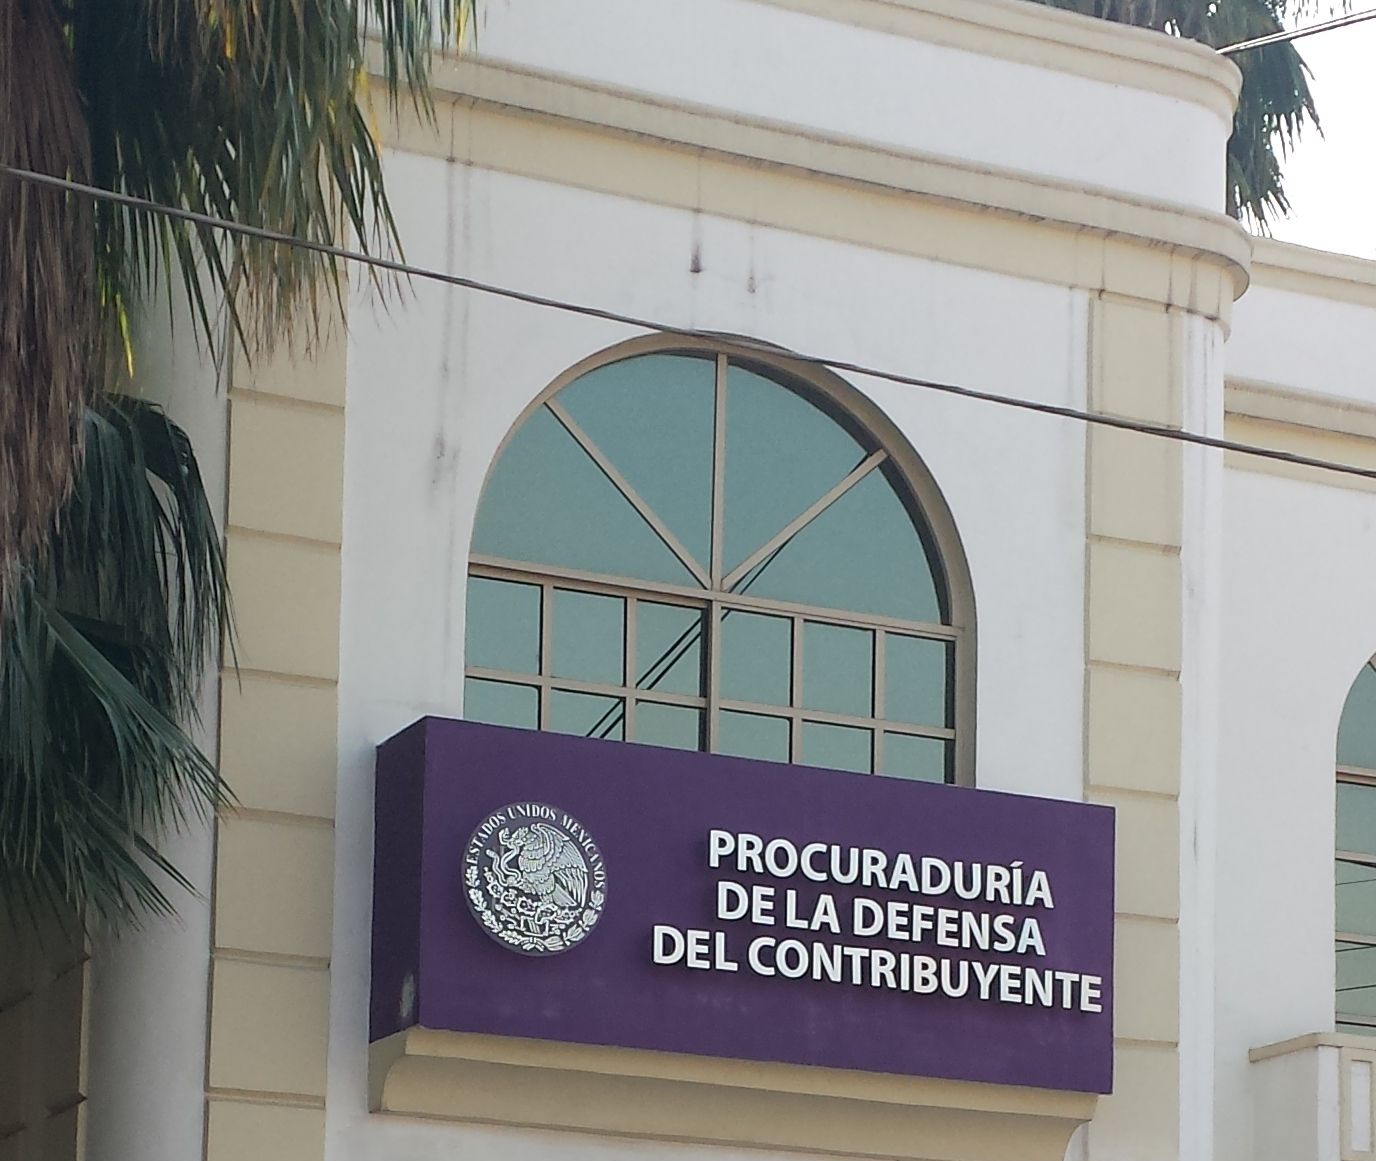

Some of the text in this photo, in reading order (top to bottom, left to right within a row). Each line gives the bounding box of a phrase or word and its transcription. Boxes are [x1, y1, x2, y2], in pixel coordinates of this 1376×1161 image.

[466, 803, 606, 889] ESTADOS UNIDOS MEXICANOS
[708, 829, 1055, 909] PROCURADURÍA
[717, 881, 1047, 956] DE LA DEFENSA
[653, 925, 1103, 1013] DEL CONTRIBUYENTE
